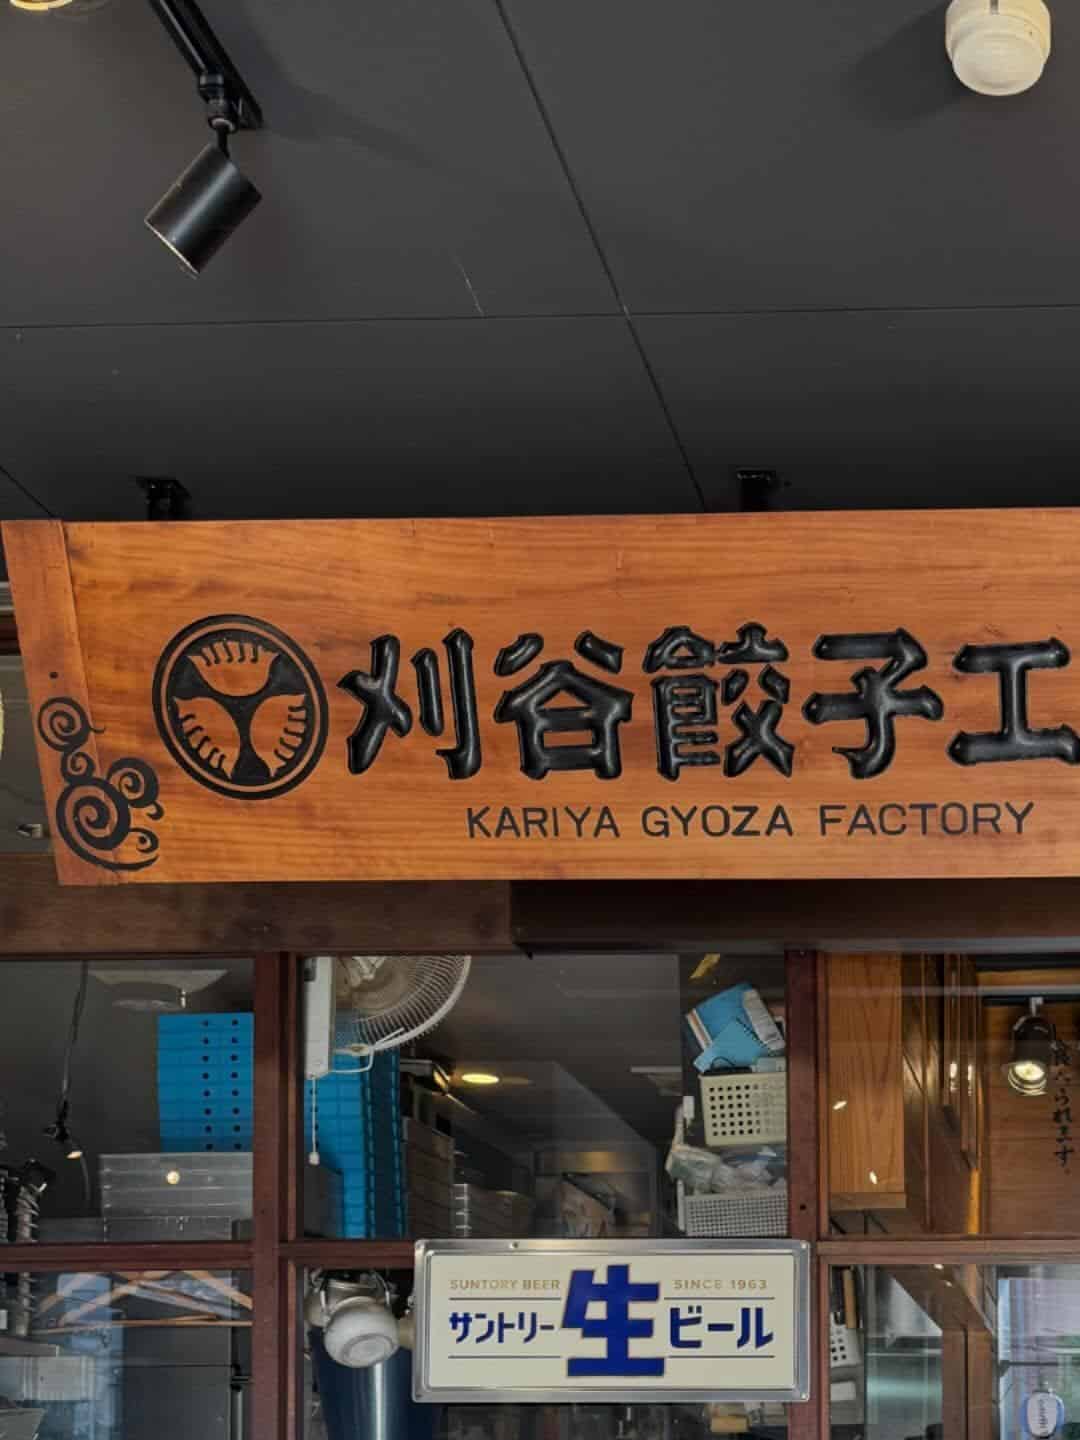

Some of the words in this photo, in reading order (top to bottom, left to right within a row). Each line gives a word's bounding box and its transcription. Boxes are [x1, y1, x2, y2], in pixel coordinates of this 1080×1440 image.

[468, 806, 620, 839] KARIYA
[641, 804, 793, 838] GYOZA
[820, 801, 1035, 837] FACTORY
[449, 1278, 518, 1290] SUNTORY
[522, 1278, 561, 1290] BEER
[673, 1278, 722, 1290] SINCE
[731, 1278, 768, 1290] 1963
